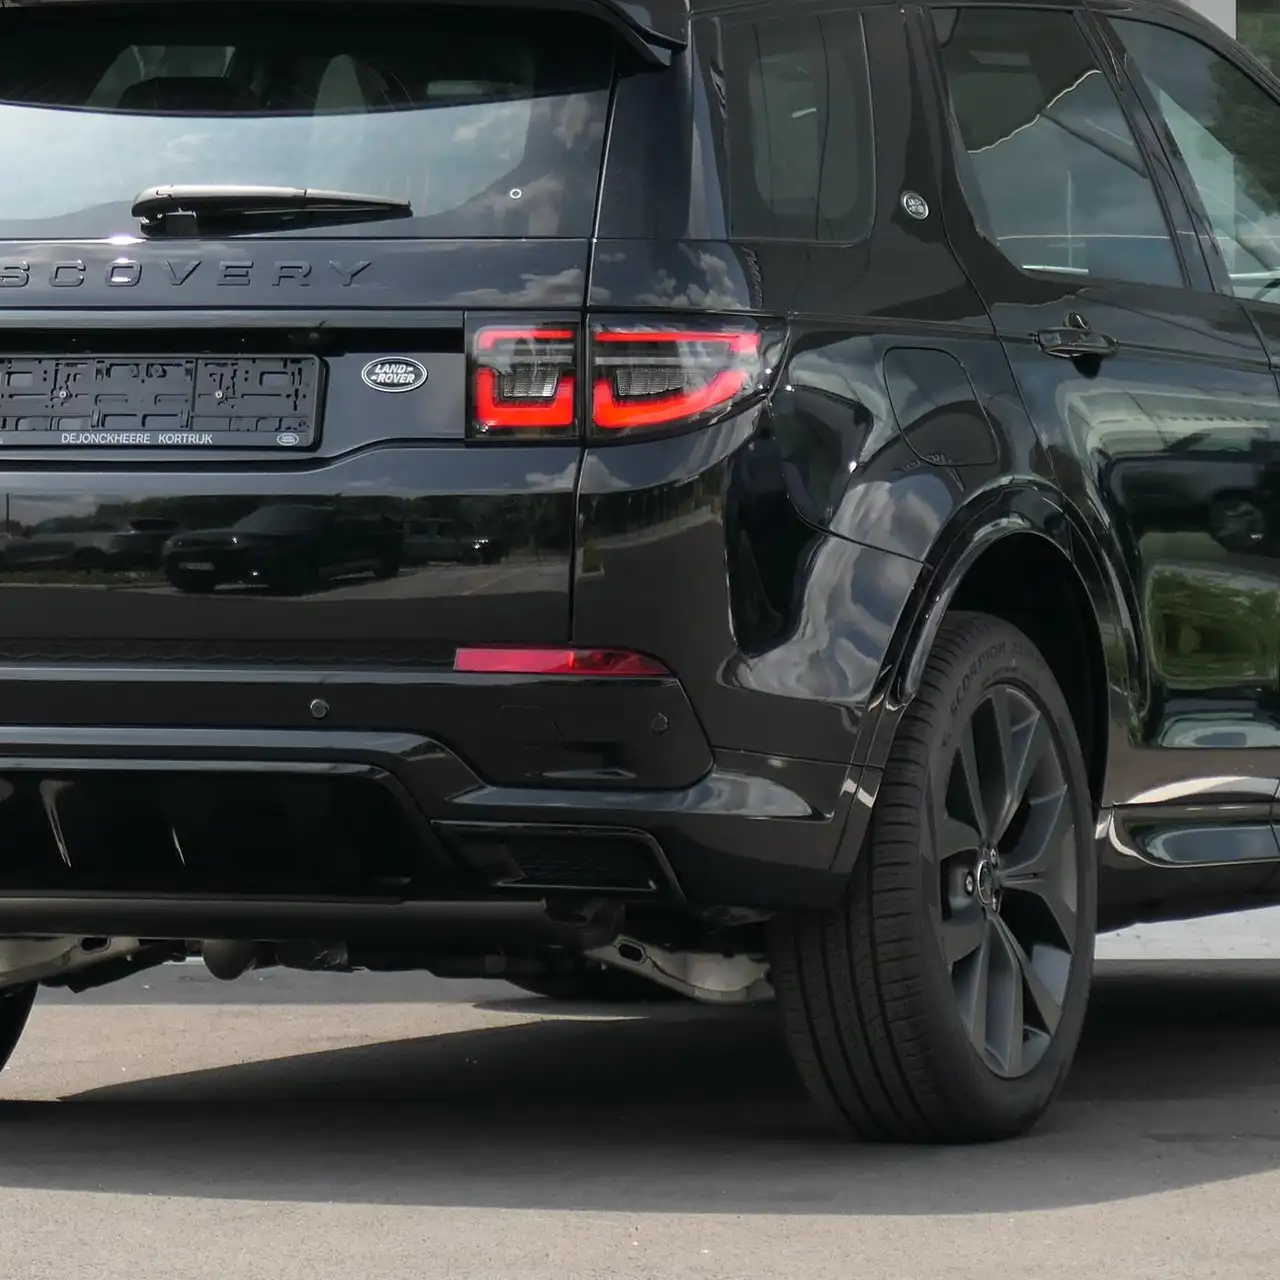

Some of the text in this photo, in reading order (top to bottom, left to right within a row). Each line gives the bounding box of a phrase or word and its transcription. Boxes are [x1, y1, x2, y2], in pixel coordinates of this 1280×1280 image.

[374, 363, 407, 374] LAND
[376, 373, 416, 384] ROVER
[60, 432, 214, 445] DEJONCKHEERE KORTRIJK
